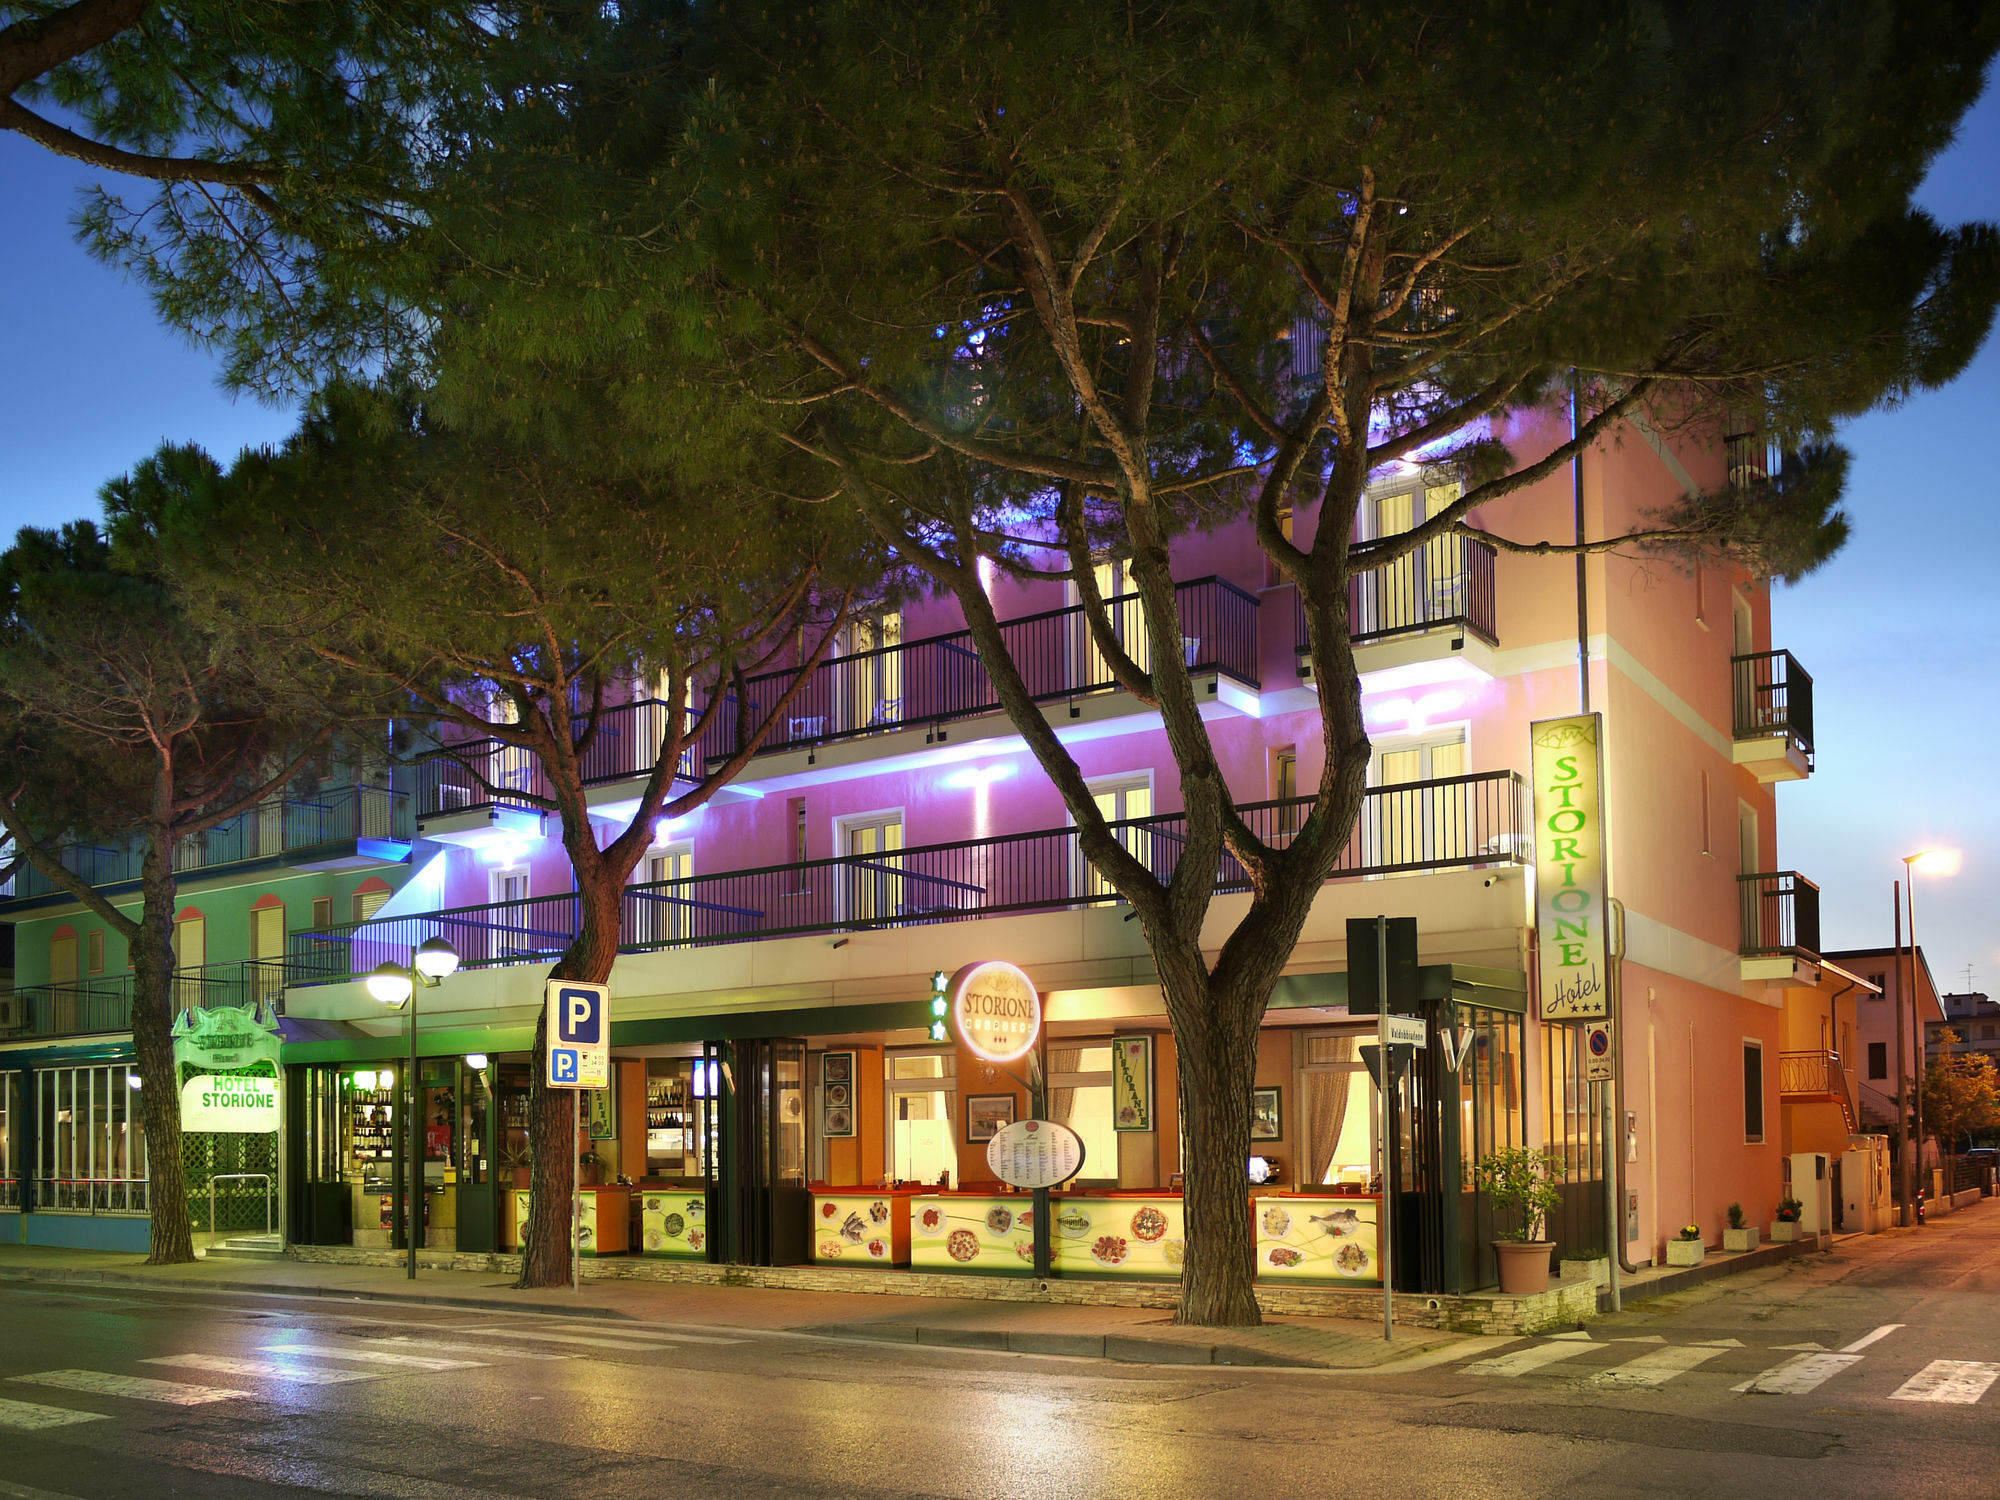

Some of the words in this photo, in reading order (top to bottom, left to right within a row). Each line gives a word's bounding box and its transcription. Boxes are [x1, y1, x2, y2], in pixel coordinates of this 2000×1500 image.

[1547, 756, 1591, 967] STORIONE
[1547, 963, 1601, 1013] Hotel
[568, 996, 592, 1035] P
[964, 992, 1035, 1019] STORIONE
[557, 1053, 573, 1078] P
[202, 1092, 274, 1108] STORIONE
[214, 1077, 260, 1092] HOTEL
[1115, 1043, 1147, 1125] RISTORANTE
